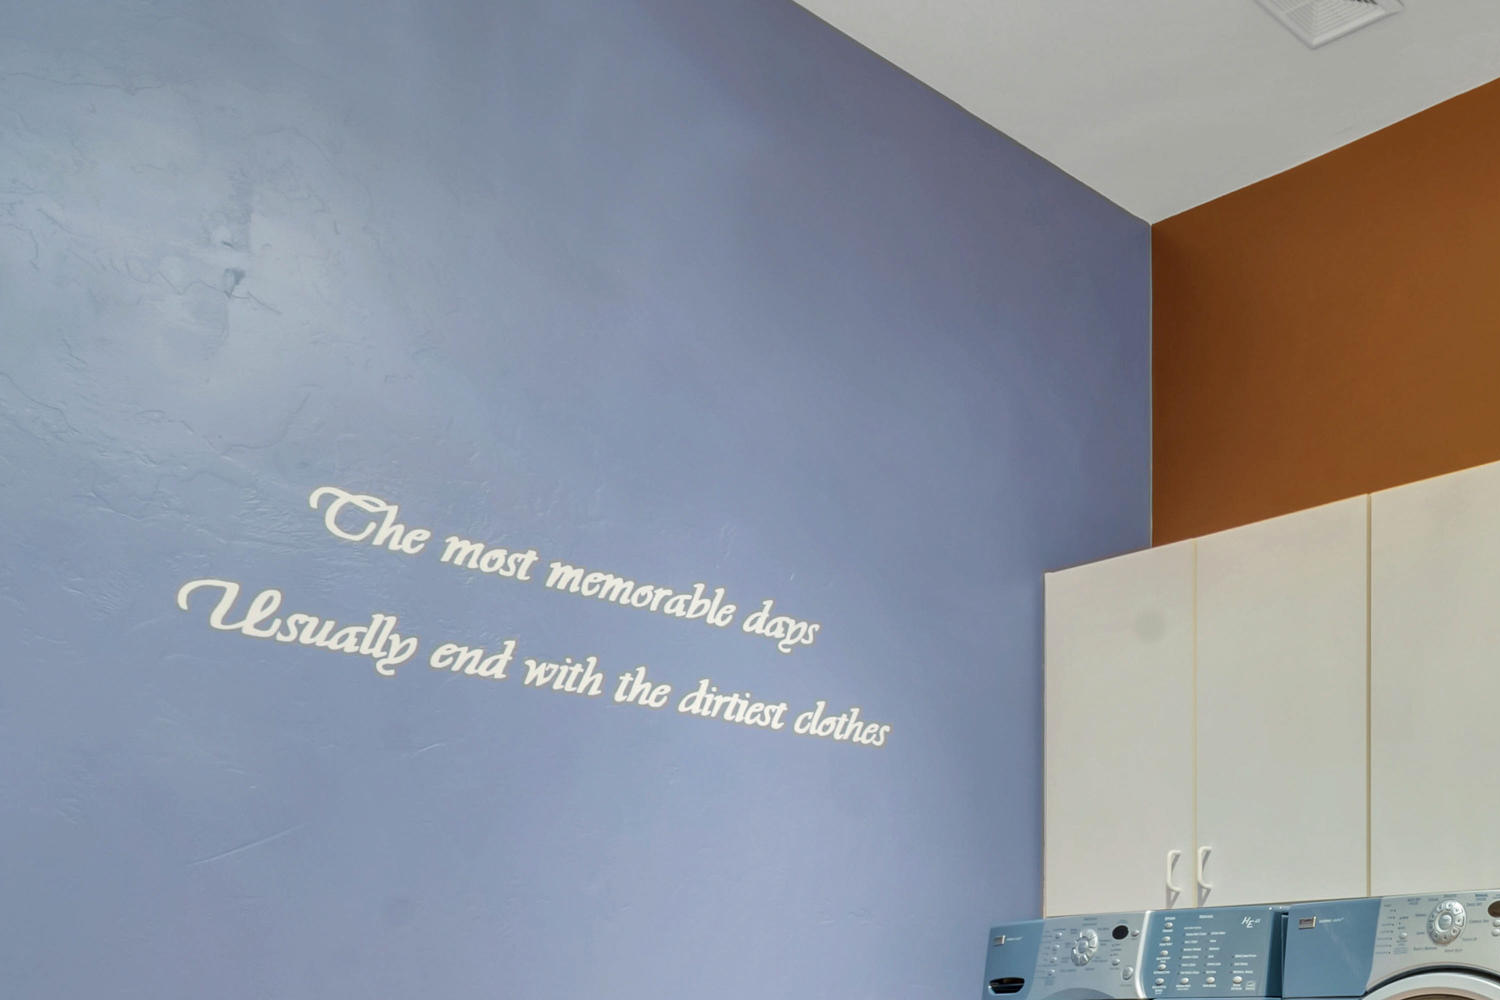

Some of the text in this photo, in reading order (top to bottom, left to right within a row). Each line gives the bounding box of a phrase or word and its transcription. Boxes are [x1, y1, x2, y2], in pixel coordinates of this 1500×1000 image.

[309, 486, 821, 654] The most memorable days
[177, 579, 891, 747] Usually end with the dirtiest clothes
